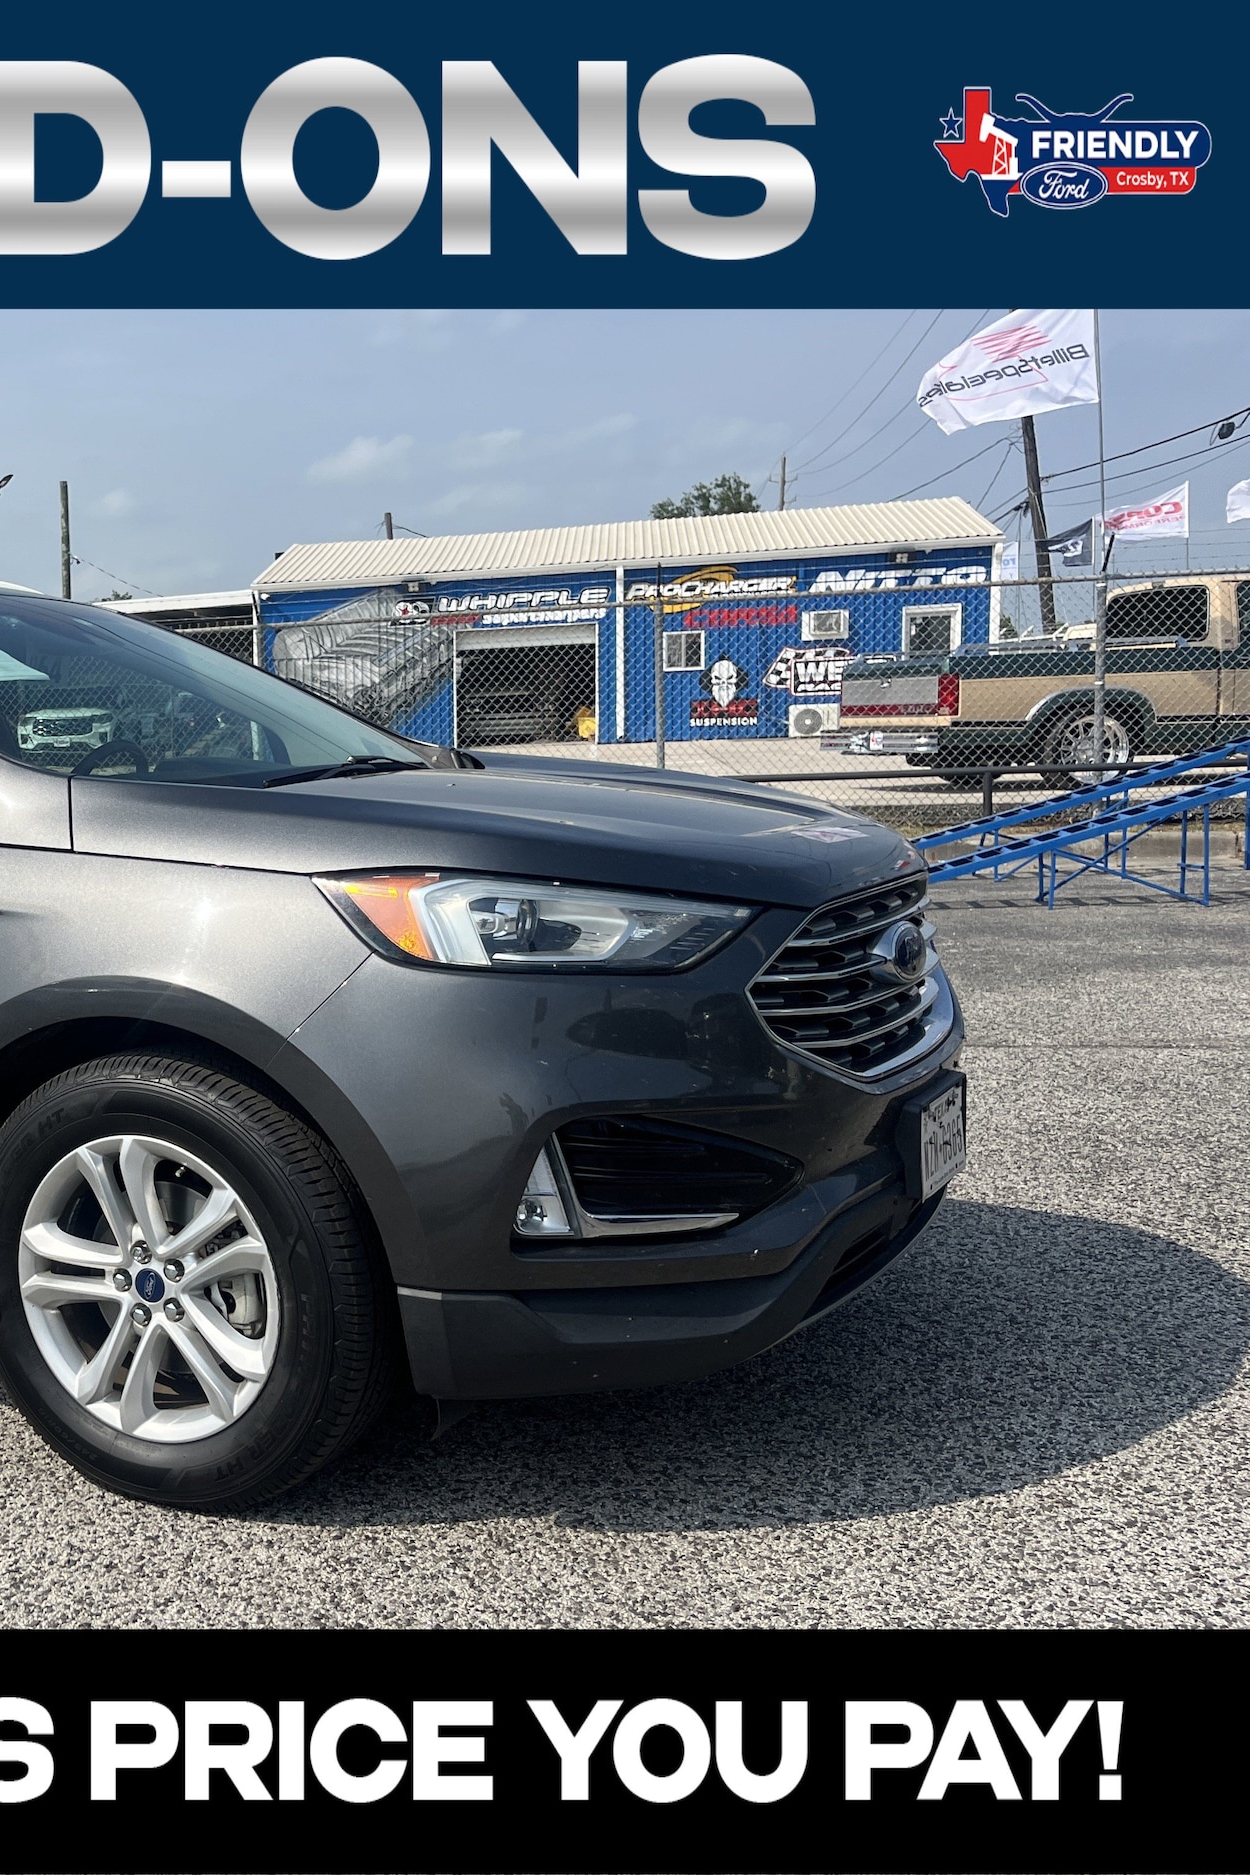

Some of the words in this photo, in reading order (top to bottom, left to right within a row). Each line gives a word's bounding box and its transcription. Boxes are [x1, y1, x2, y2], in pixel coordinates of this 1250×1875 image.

[809, 565, 987, 594] NITTO
[438, 588, 610, 612] WHIPPLE
[689, 716, 758, 728] SUSPENSION
